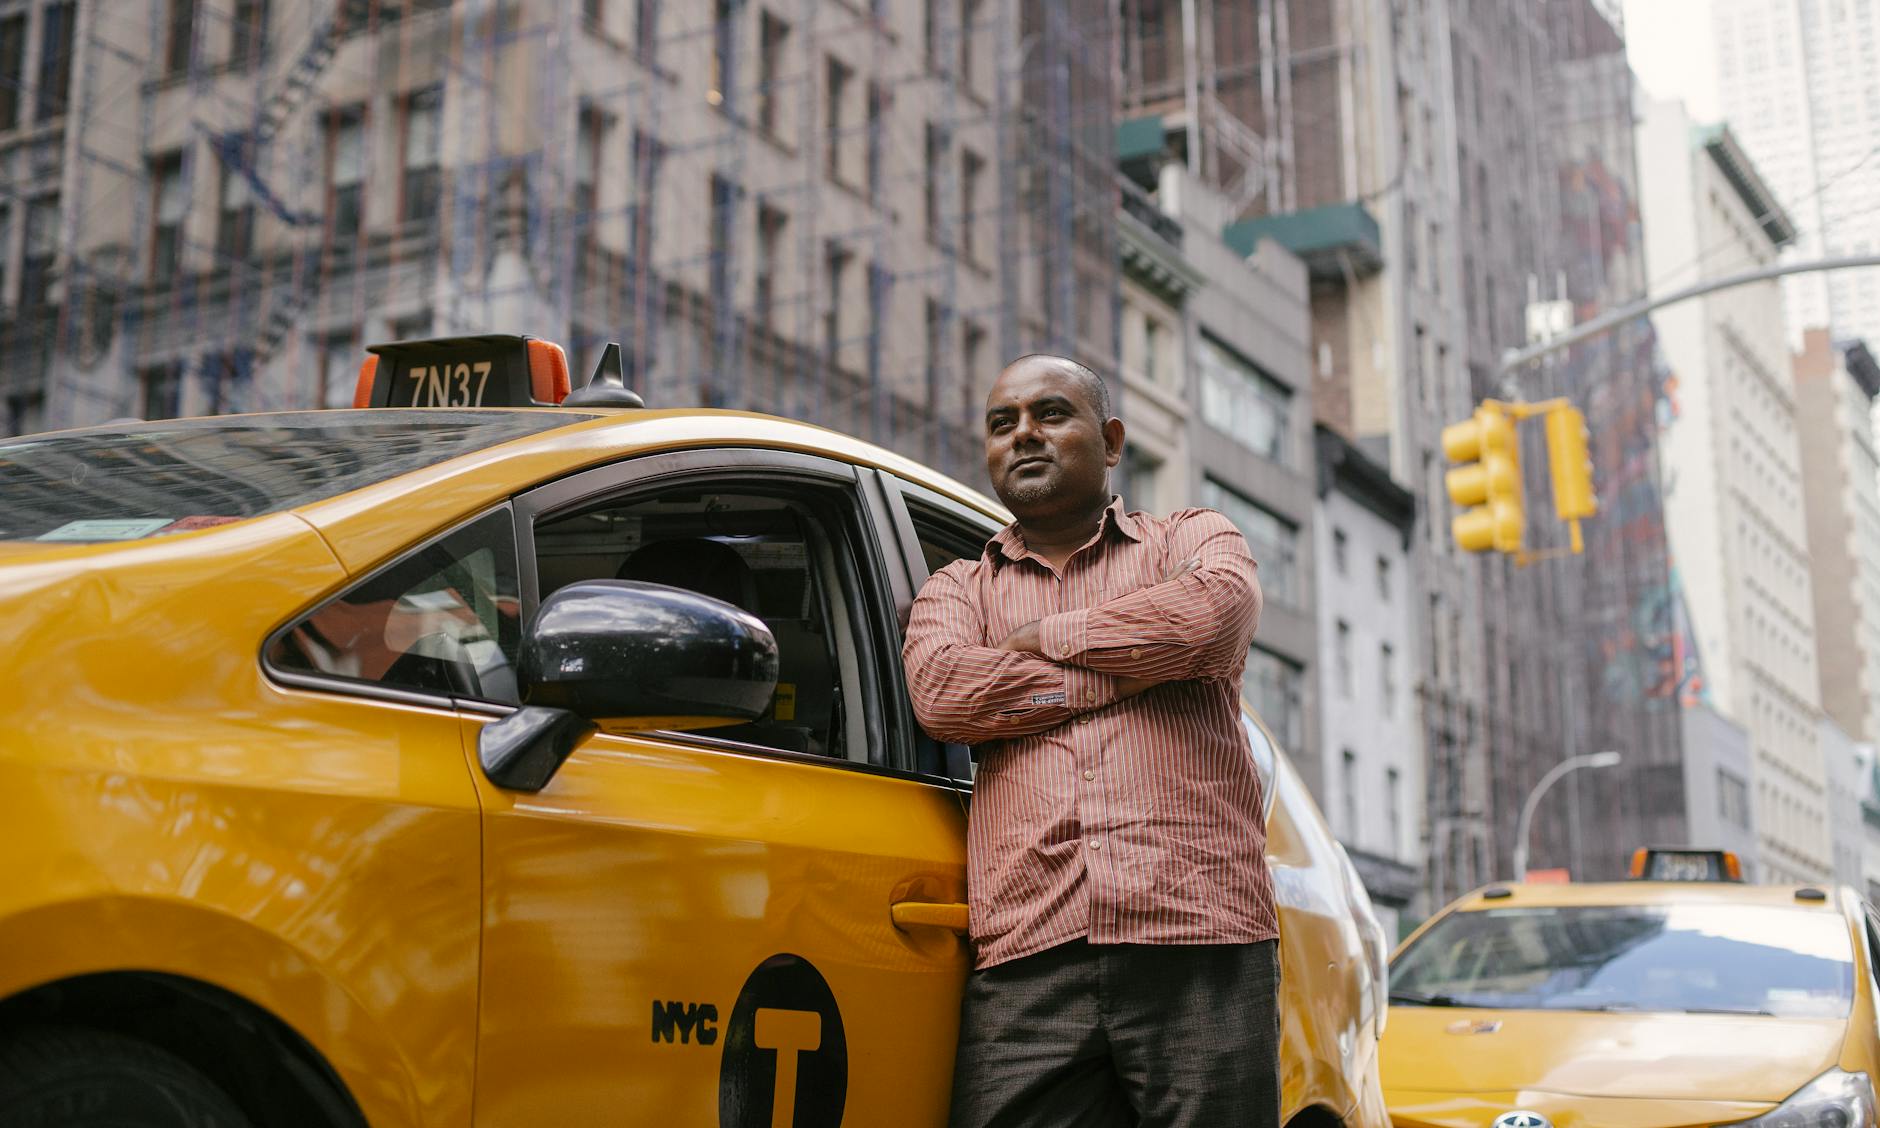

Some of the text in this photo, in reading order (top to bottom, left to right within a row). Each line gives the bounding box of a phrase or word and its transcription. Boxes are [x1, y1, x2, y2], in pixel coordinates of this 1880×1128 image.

[409, 361, 492, 407] 7N37
[652, 1000, 718, 1045] NYC
[754, 1007, 822, 1128] T
